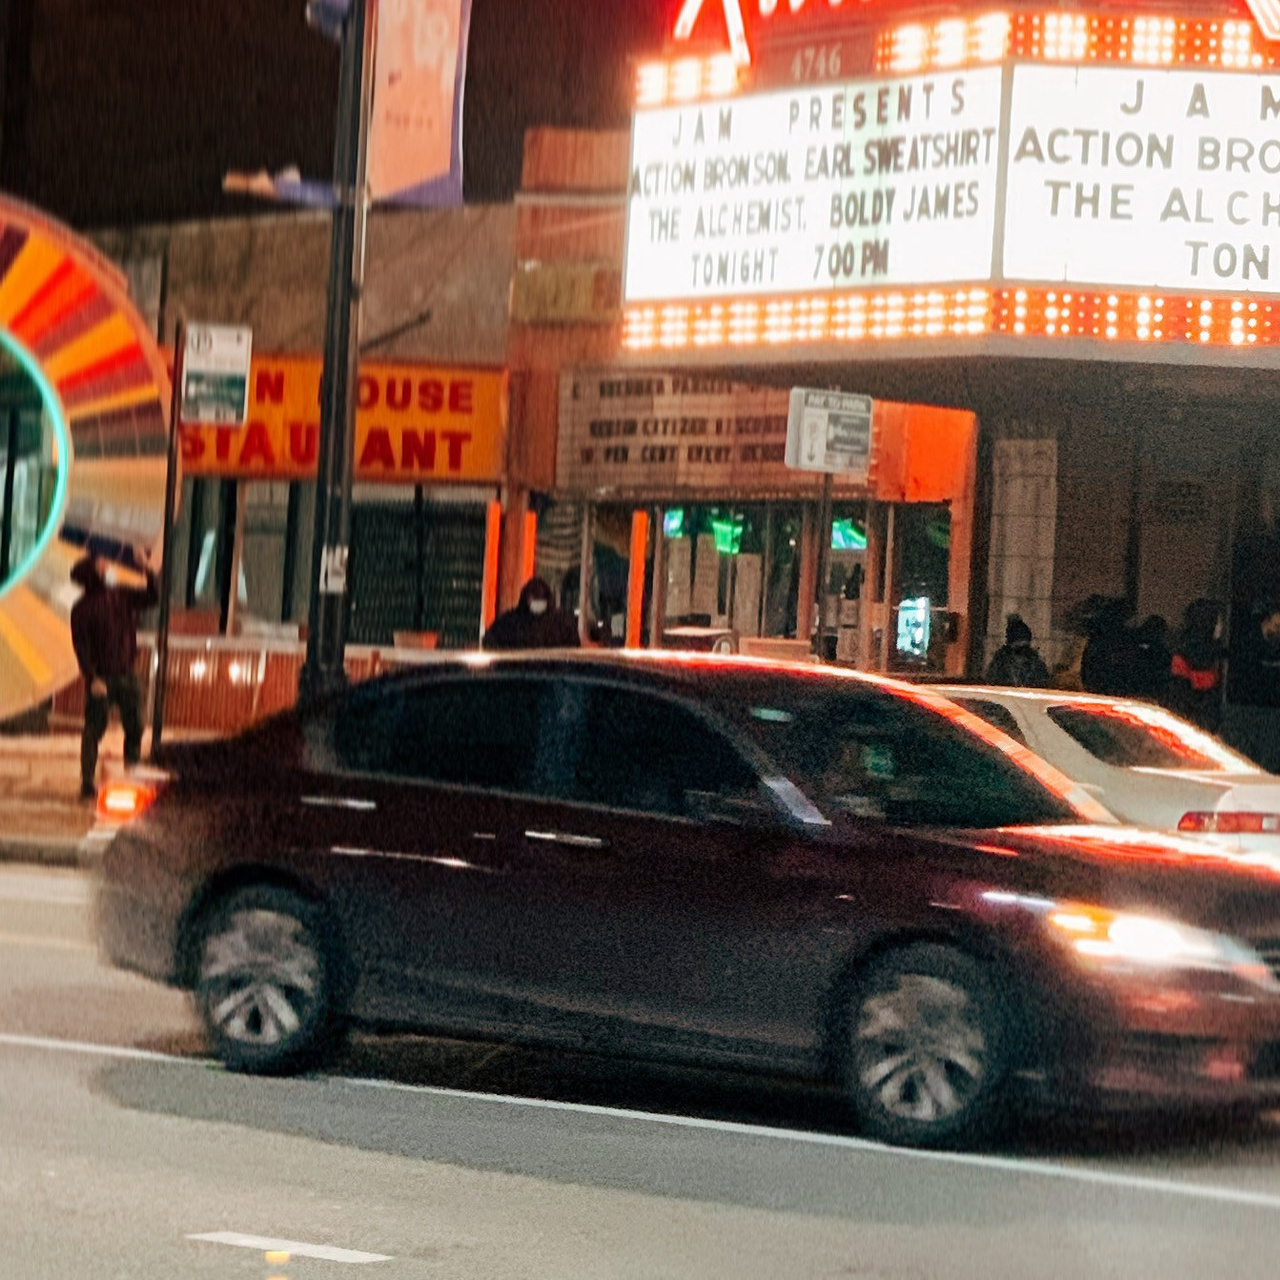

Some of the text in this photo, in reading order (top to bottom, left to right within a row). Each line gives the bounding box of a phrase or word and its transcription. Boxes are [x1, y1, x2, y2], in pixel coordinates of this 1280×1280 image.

[790, 41, 842, 82] 4746
[672, 78, 966, 147] JAM PRESENTS
[631, 162, 696, 201] ACTION
[804, 142, 855, 182] EARL
[863, 127, 997, 176] SWEATSHIRT
[1013, 126, 1175, 170] ACTION
[648, 207, 681, 243] THE
[829, 187, 898, 229] BOLDY
[902, 181, 980, 222] JAMES
[1043, 179, 1135, 220] THE
[691, 246, 780, 289] TONIGHT
[860, 237, 891, 276] PM
[318, 376, 474, 414] OUSE
[181, 420, 472, 470] STAUANT
